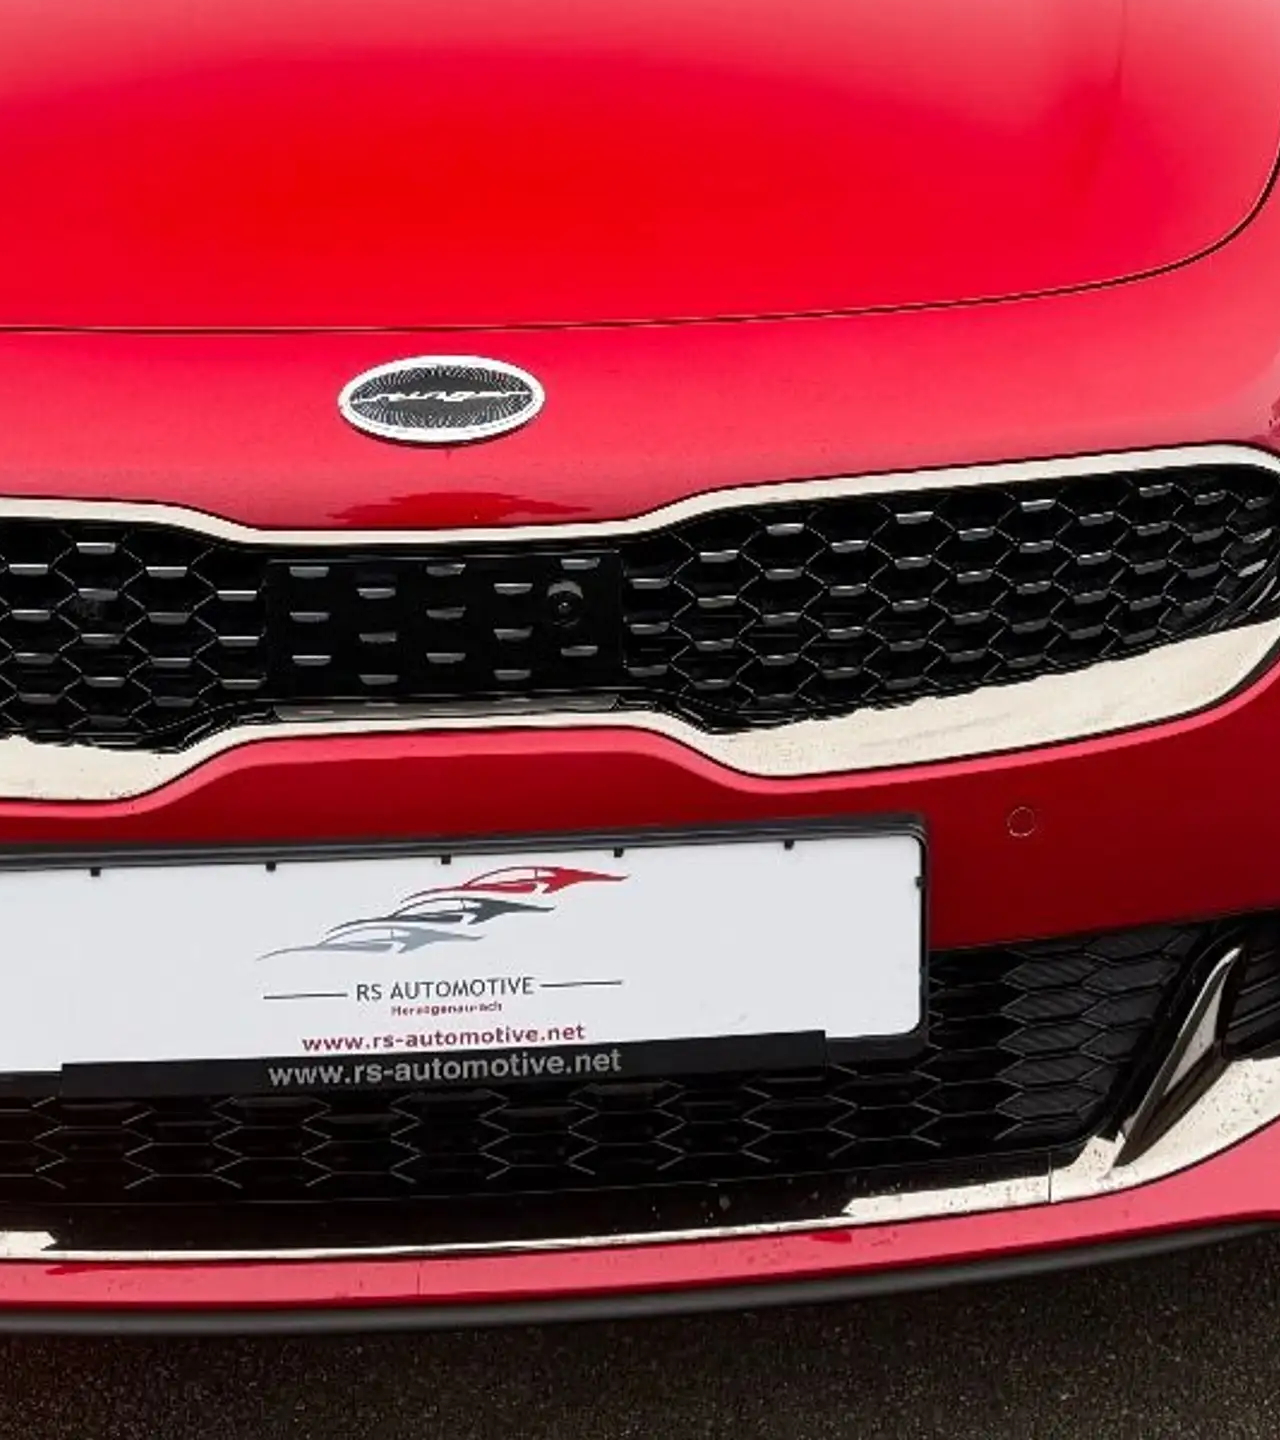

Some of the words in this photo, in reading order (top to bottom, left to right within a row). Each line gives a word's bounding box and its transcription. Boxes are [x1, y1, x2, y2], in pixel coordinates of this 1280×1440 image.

[356, 982, 382, 1002] RS
[389, 977, 535, 1001] AUTOMOTIVE
[301, 1023, 587, 1052] www.rs-automotive.net
[267, 1048, 622, 1087] www.rs-automotive.net
